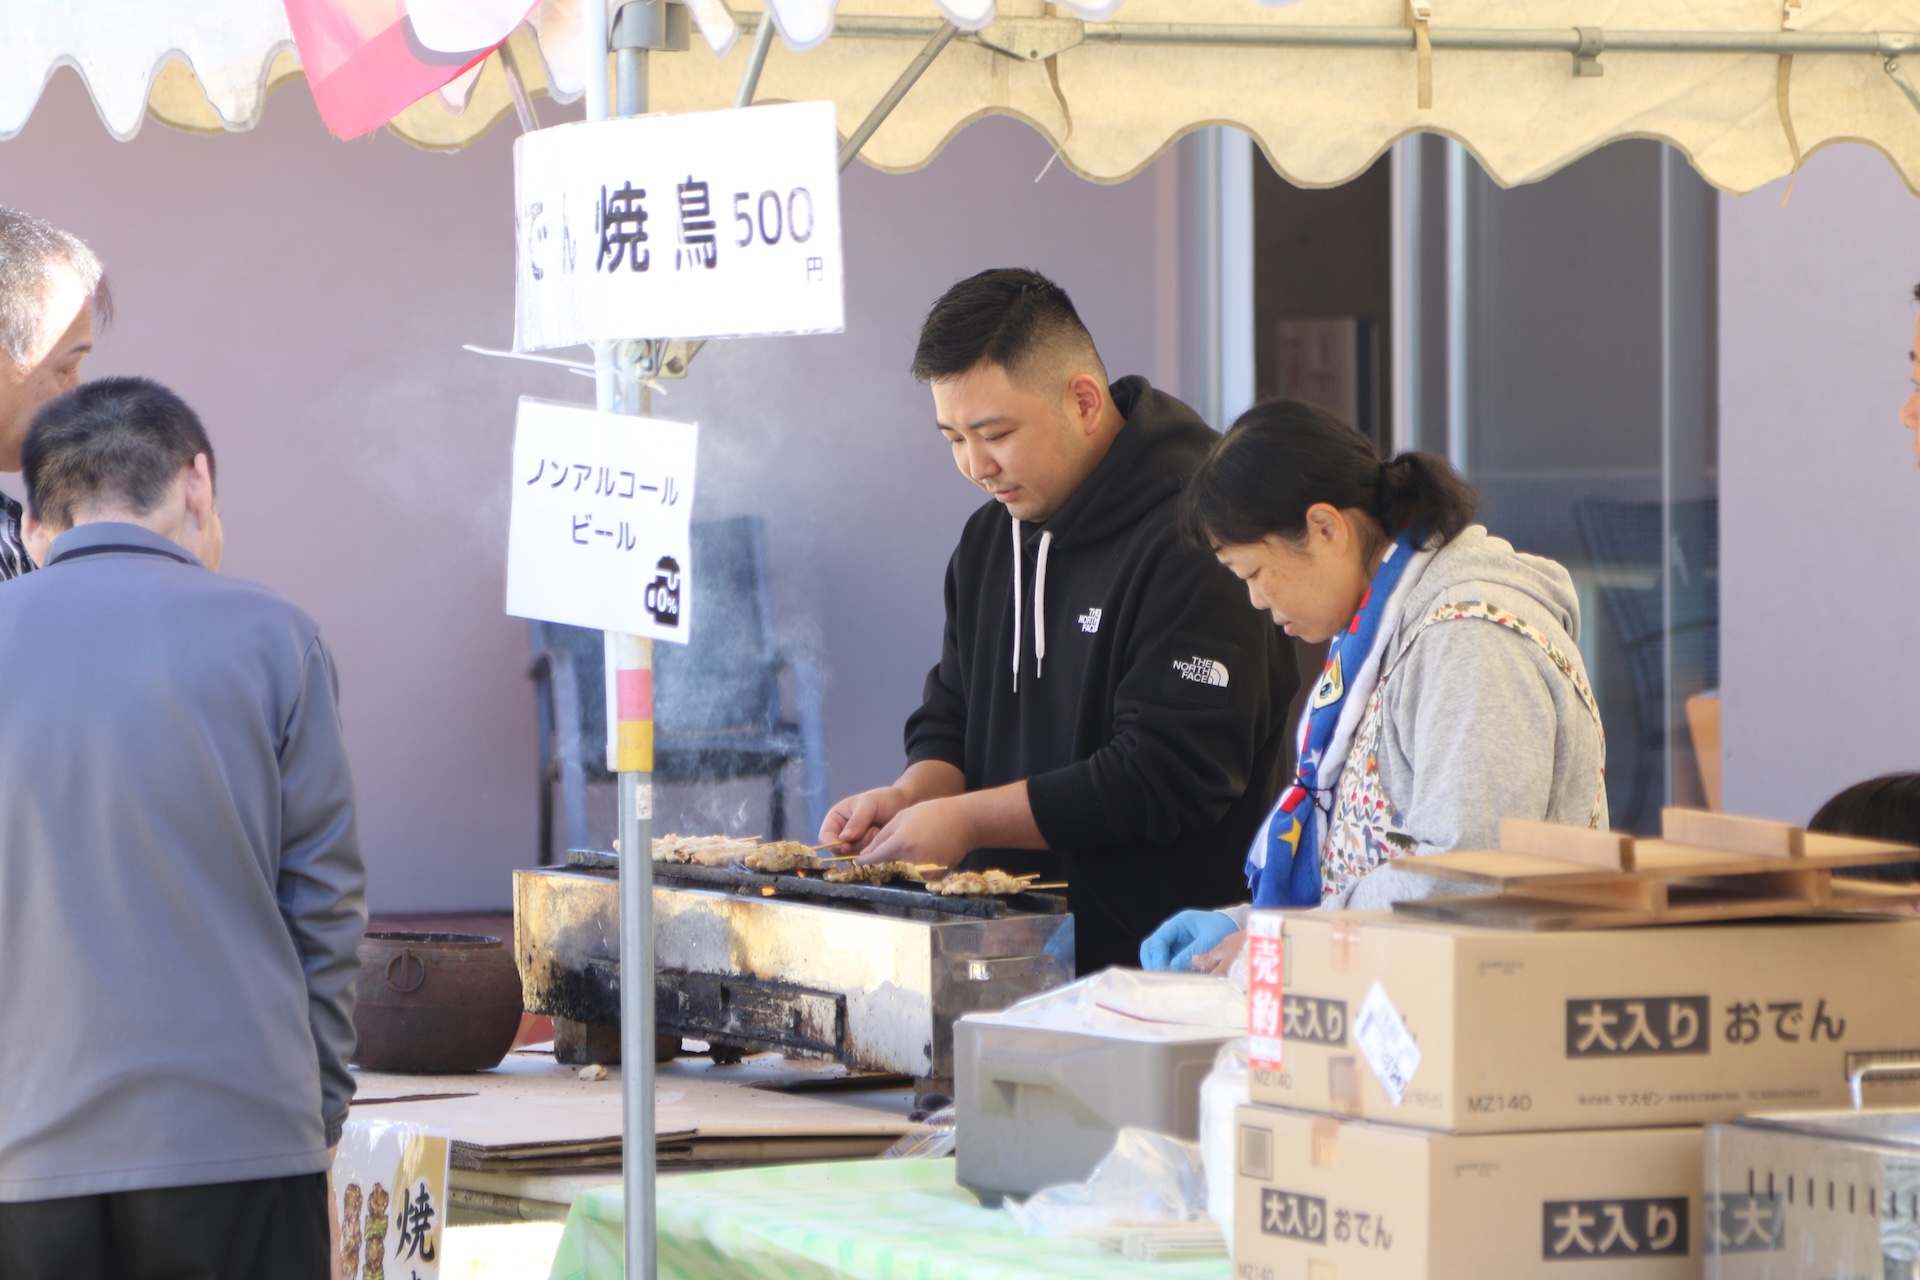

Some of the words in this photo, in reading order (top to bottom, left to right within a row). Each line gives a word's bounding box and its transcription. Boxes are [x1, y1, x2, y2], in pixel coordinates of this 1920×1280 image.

[595, 175, 717, 274] 焼鳥
[733, 187, 814, 248] 500
[527, 459, 678, 507] ノンアルコール
[572, 514, 636, 551] ビール
[657, 587, 677, 615] 0%
[1173, 660, 1211, 676] NORTH
[1182, 670, 1208, 684] FACE
[1192, 656, 1212, 669] THE
[1284, 1002, 1344, 1042] 大入り
[1576, 1003, 1700, 1051] 大入り
[1725, 999, 1847, 1045] おでん
[1467, 1094, 1532, 1113] MZ140
[1265, 1193, 1324, 1239] 大入り
[1334, 1207, 1394, 1251] おでん
[1553, 1203, 1679, 1254] 大入り
